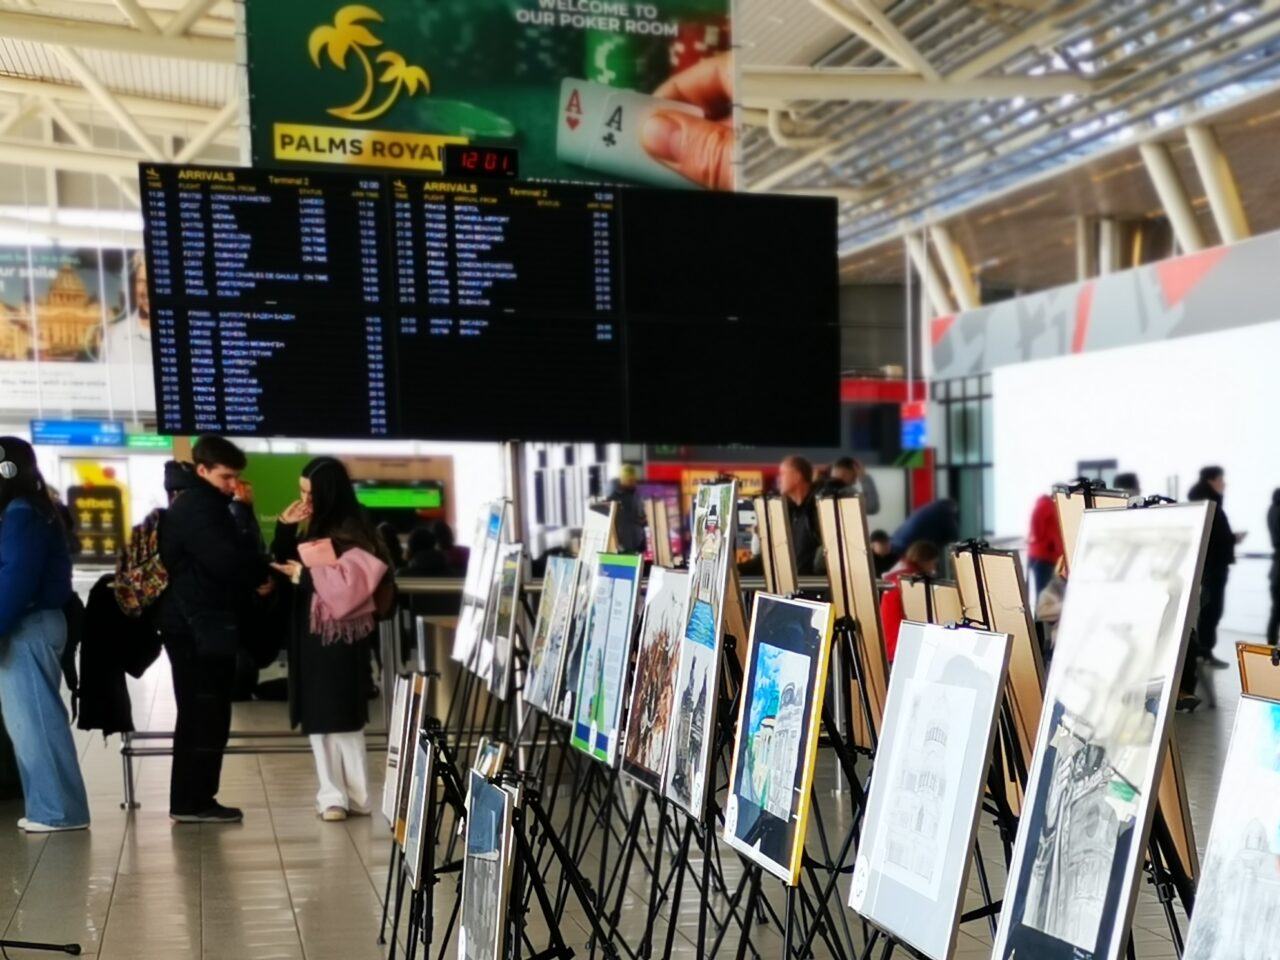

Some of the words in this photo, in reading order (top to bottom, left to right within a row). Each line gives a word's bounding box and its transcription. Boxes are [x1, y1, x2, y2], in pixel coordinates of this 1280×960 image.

[538, 0, 629, 17] WELCOME
[634, 4, 657, 19] TO
[516, 9, 554, 26] OUR
[559, 13, 620, 32] POKER
[625, 20, 679, 37] ROOM
[280, 133, 363, 156] PALMS
[178, 169, 235, 183] ARRIVALS
[423, 181, 478, 194] ARRIVALS
